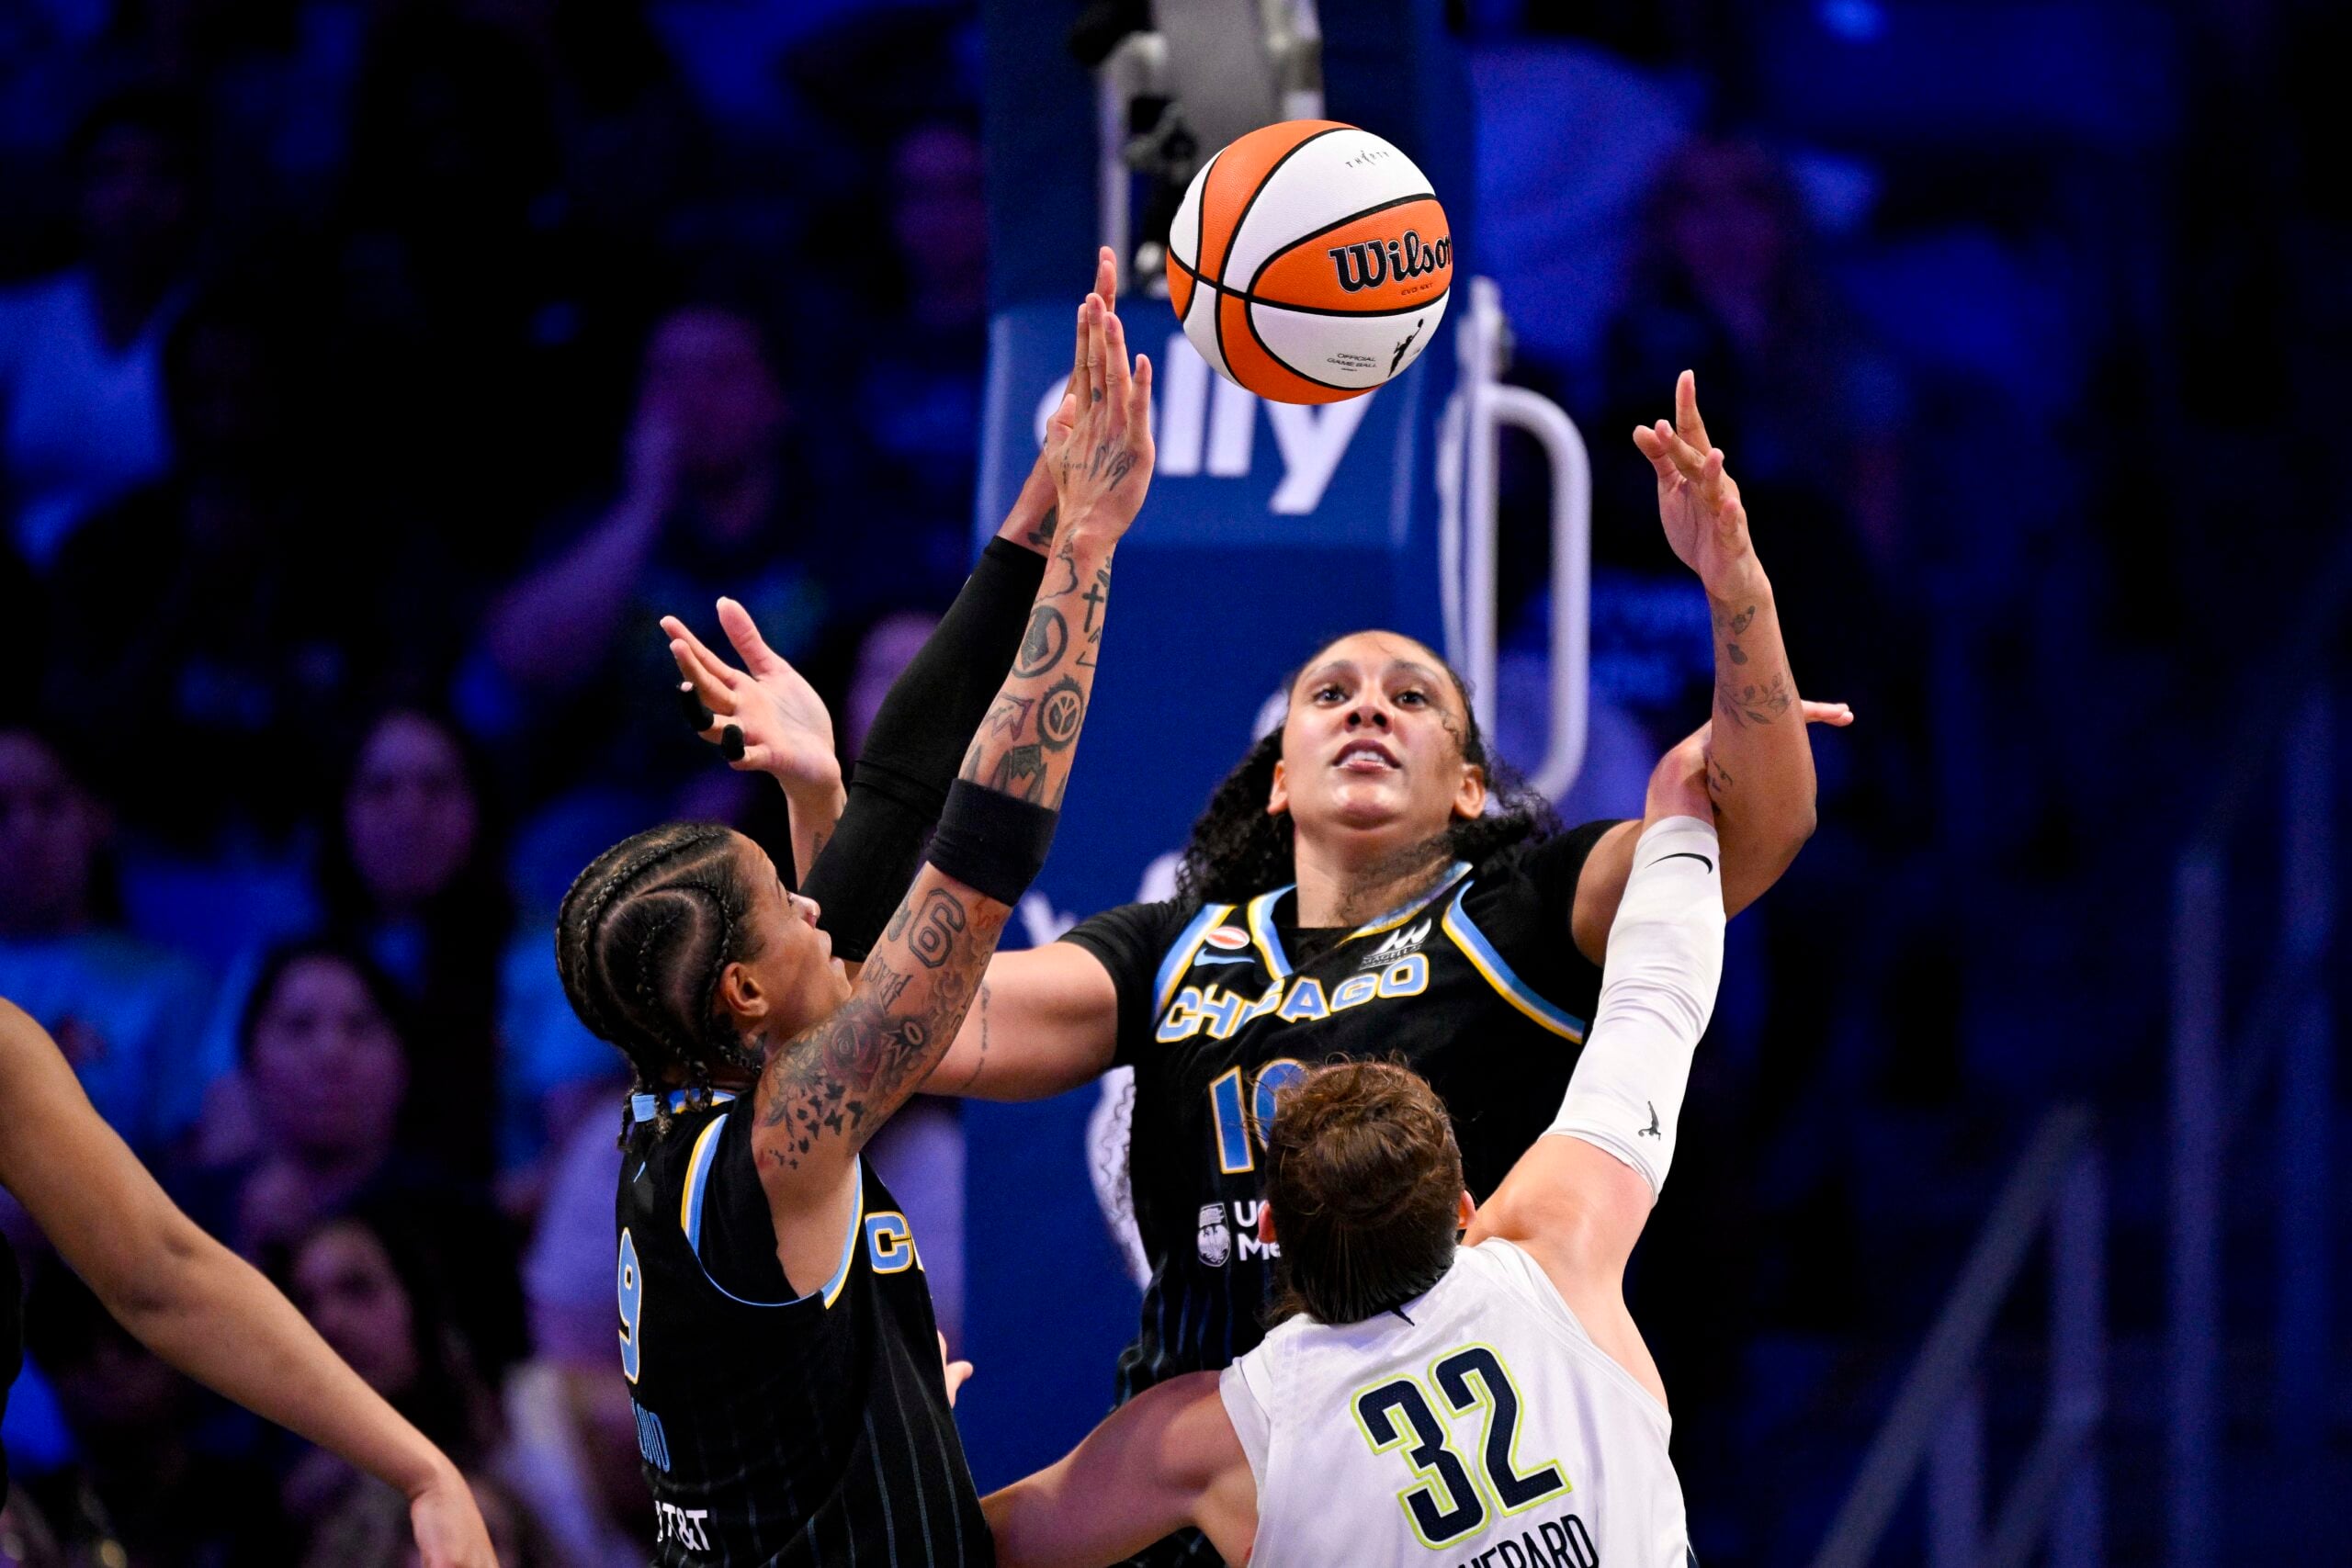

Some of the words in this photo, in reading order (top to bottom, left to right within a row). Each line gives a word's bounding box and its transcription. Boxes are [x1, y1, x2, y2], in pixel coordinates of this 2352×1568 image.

[1327, 357, 1354, 367] GAME
[1337, 353, 1375, 362] OFFICIAL
[617, 1226, 642, 1385] 9
[1350, 1341, 1574, 1551] 32
